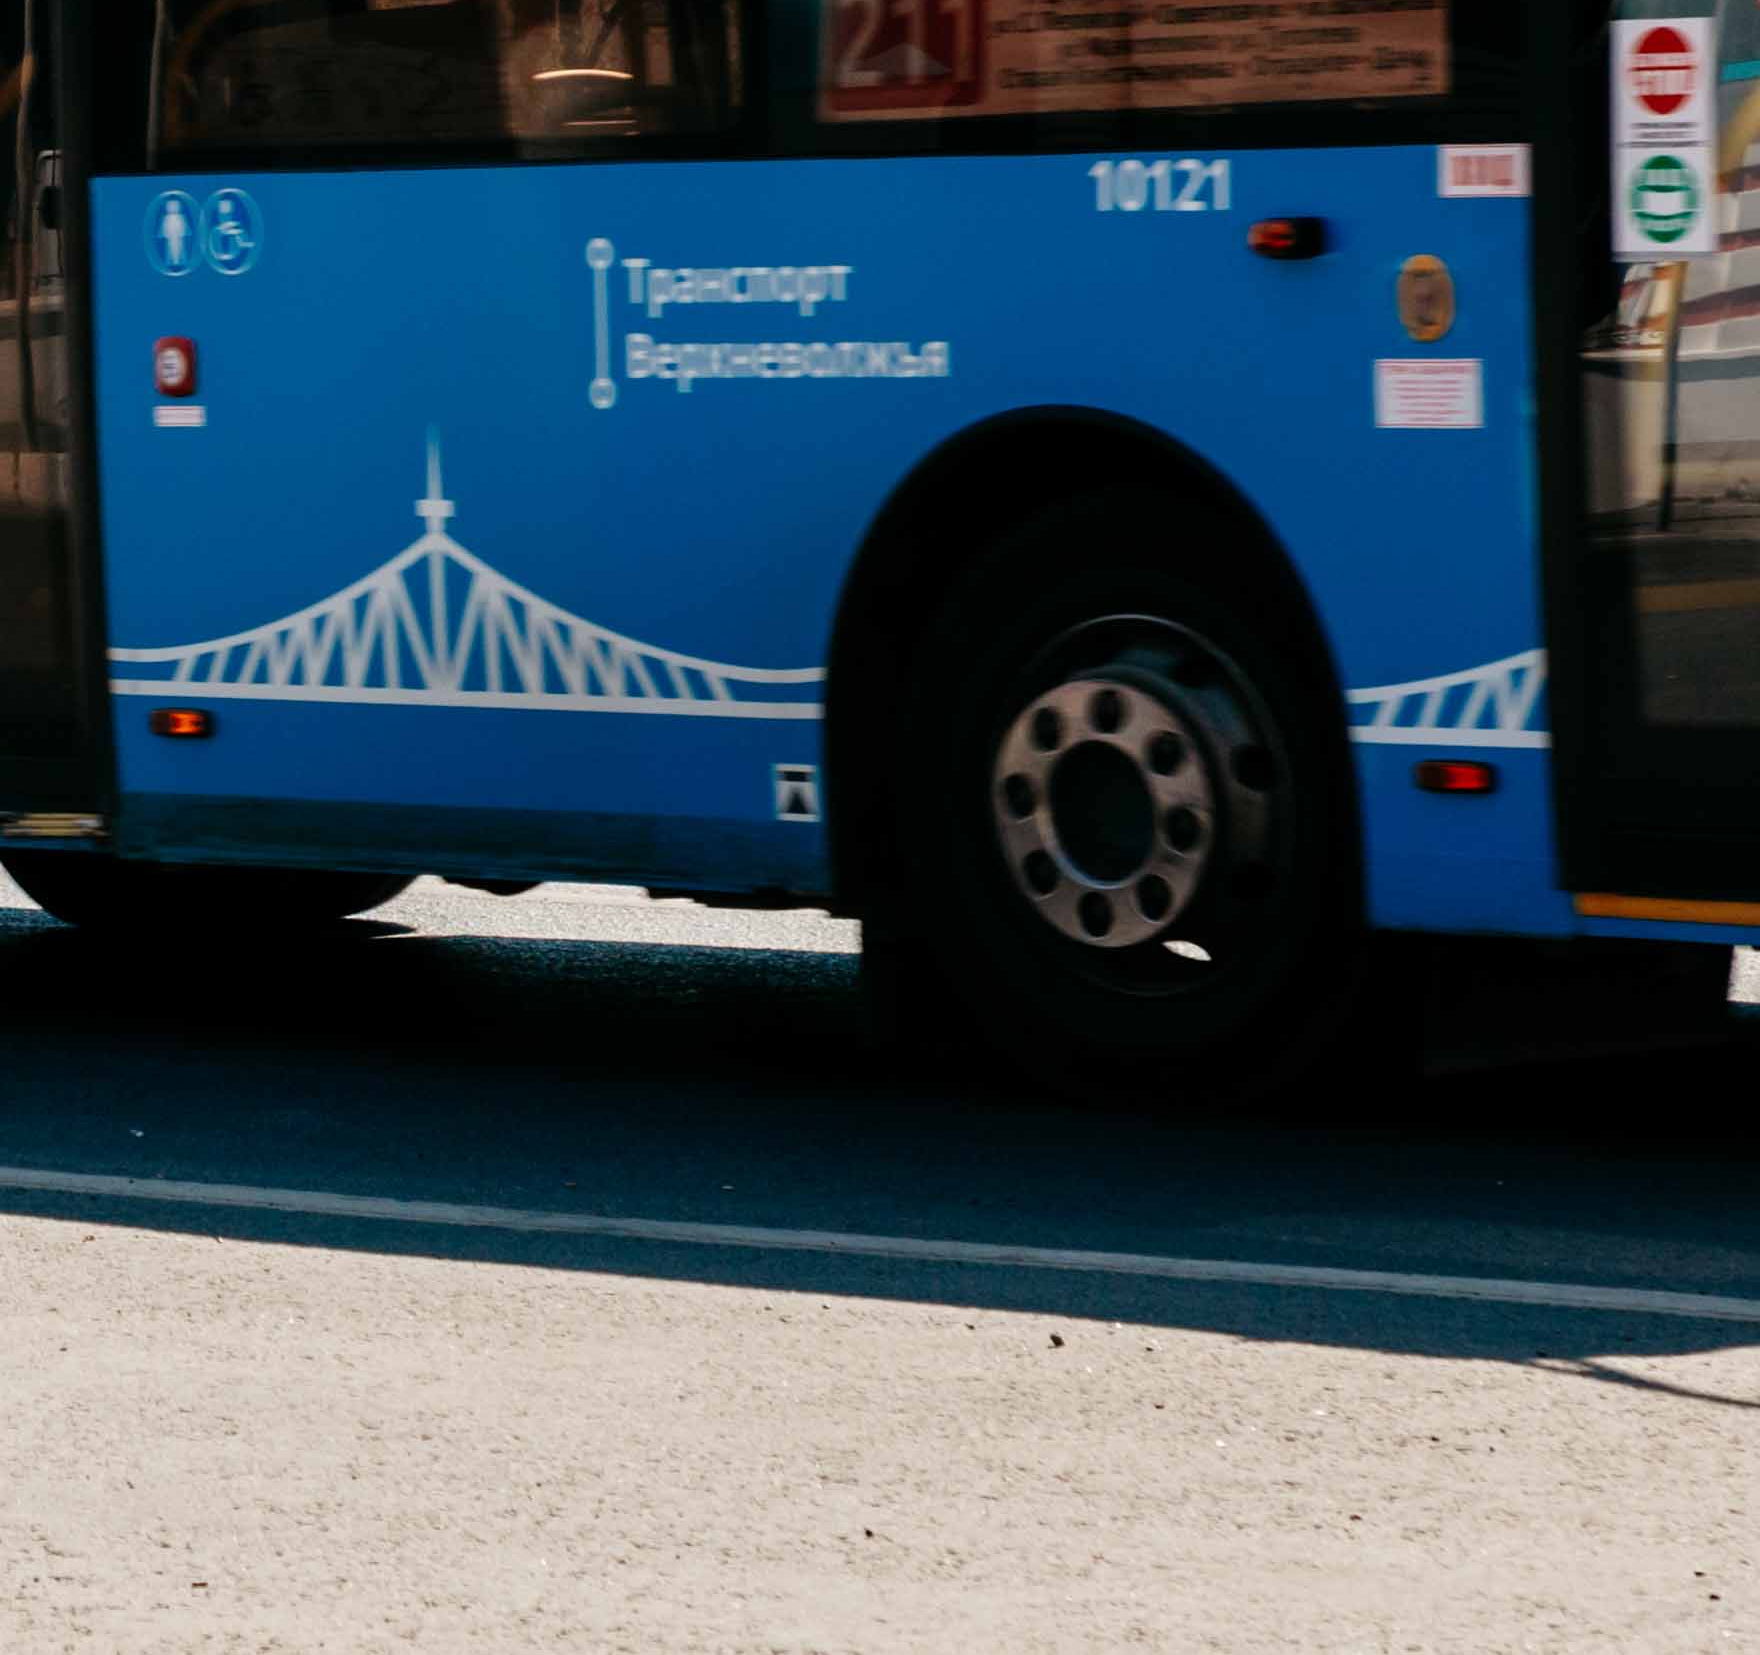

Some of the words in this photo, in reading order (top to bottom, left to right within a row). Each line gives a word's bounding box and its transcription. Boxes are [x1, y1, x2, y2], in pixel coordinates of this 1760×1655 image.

[1087, 158, 1230, 211] 10121
[621, 258, 851, 317] Транспорт
[625, 333, 949, 392] Верхневолжья
